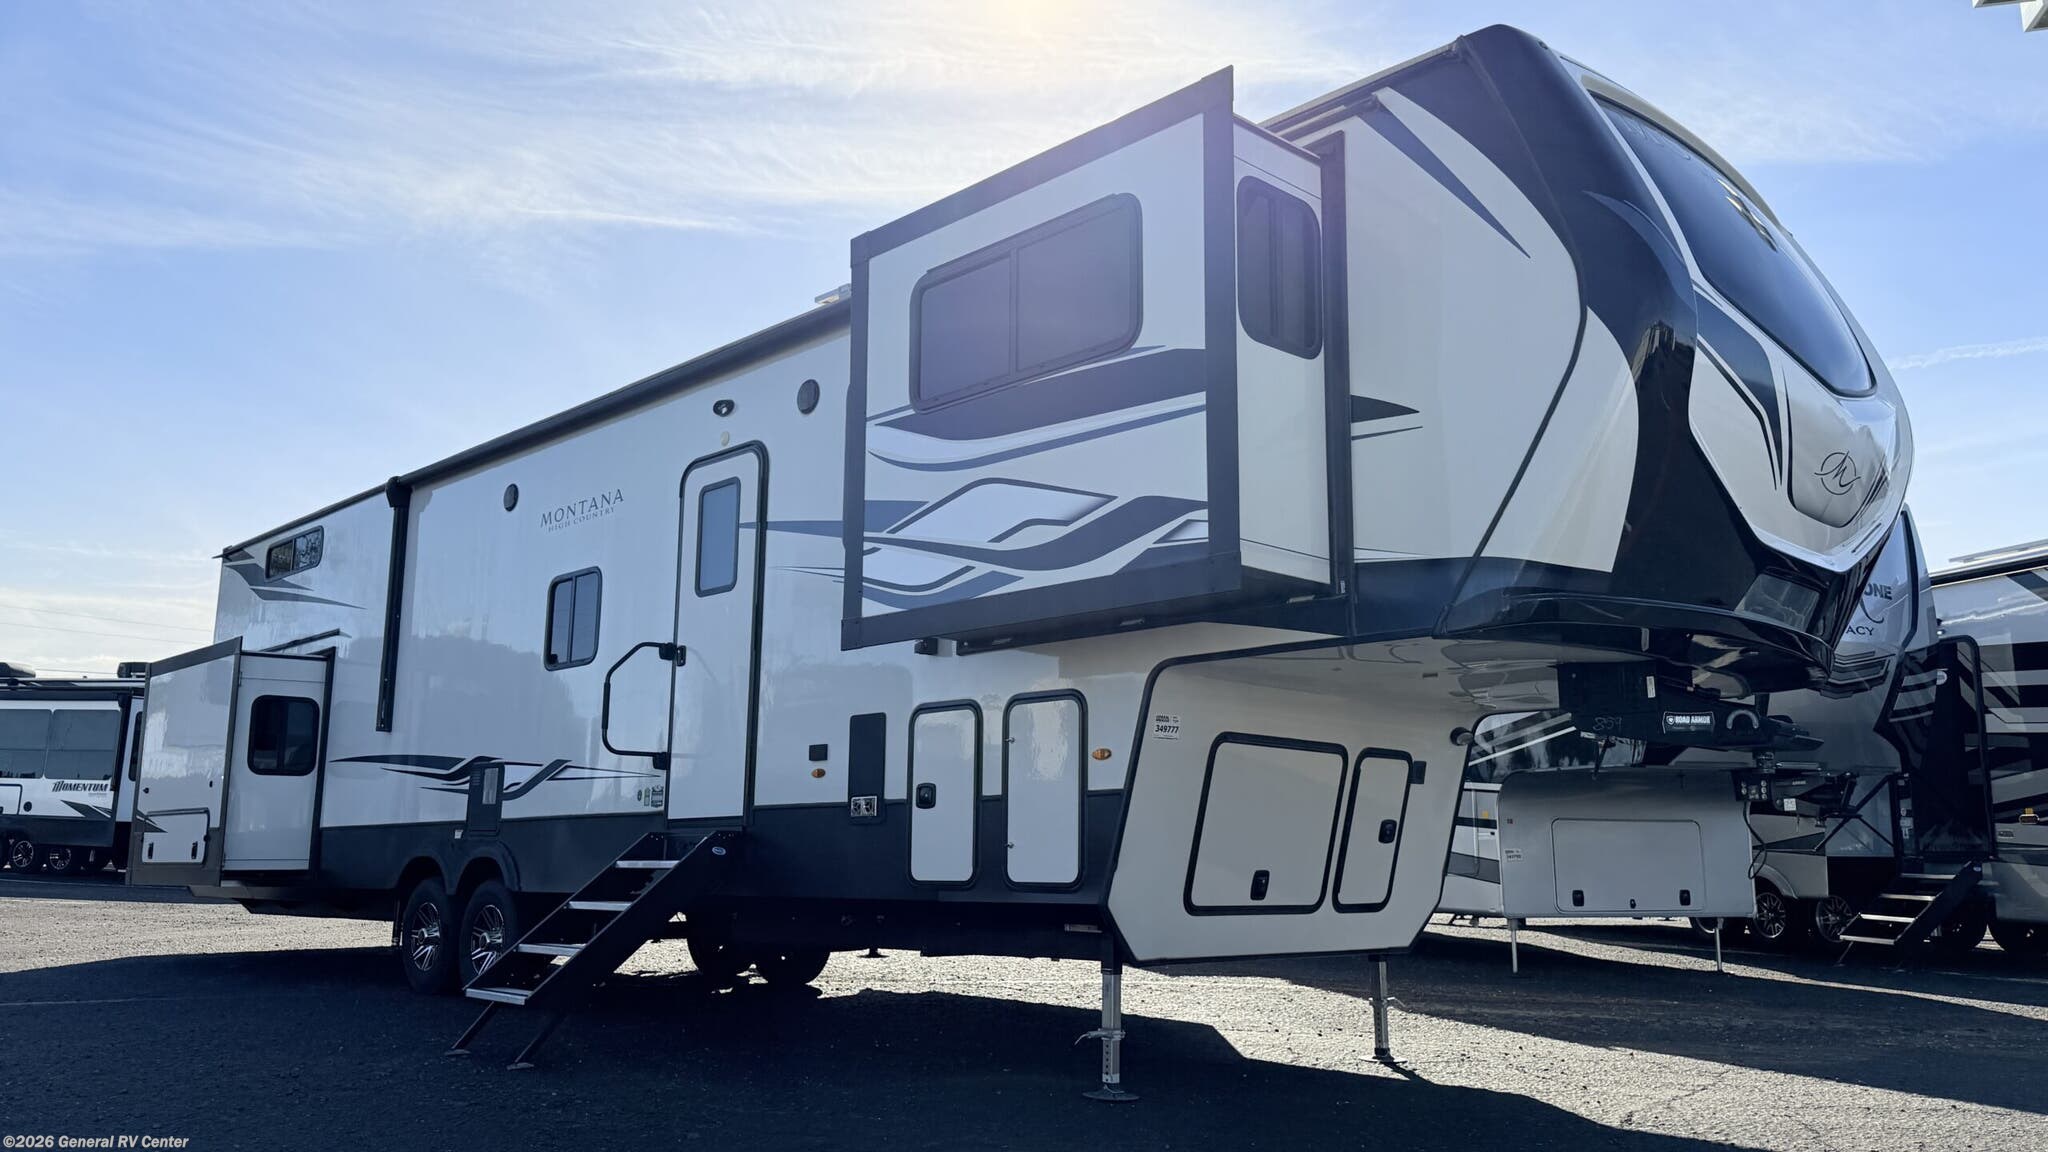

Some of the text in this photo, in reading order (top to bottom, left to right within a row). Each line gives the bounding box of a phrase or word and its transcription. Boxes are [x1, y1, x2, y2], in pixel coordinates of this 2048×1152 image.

[540, 488, 625, 528] MONTANA
[548, 506, 615, 533] HIGH COUNTRY
[1154, 724, 1180, 734] 349777
[52, 780, 109, 793] MOMENTUM
